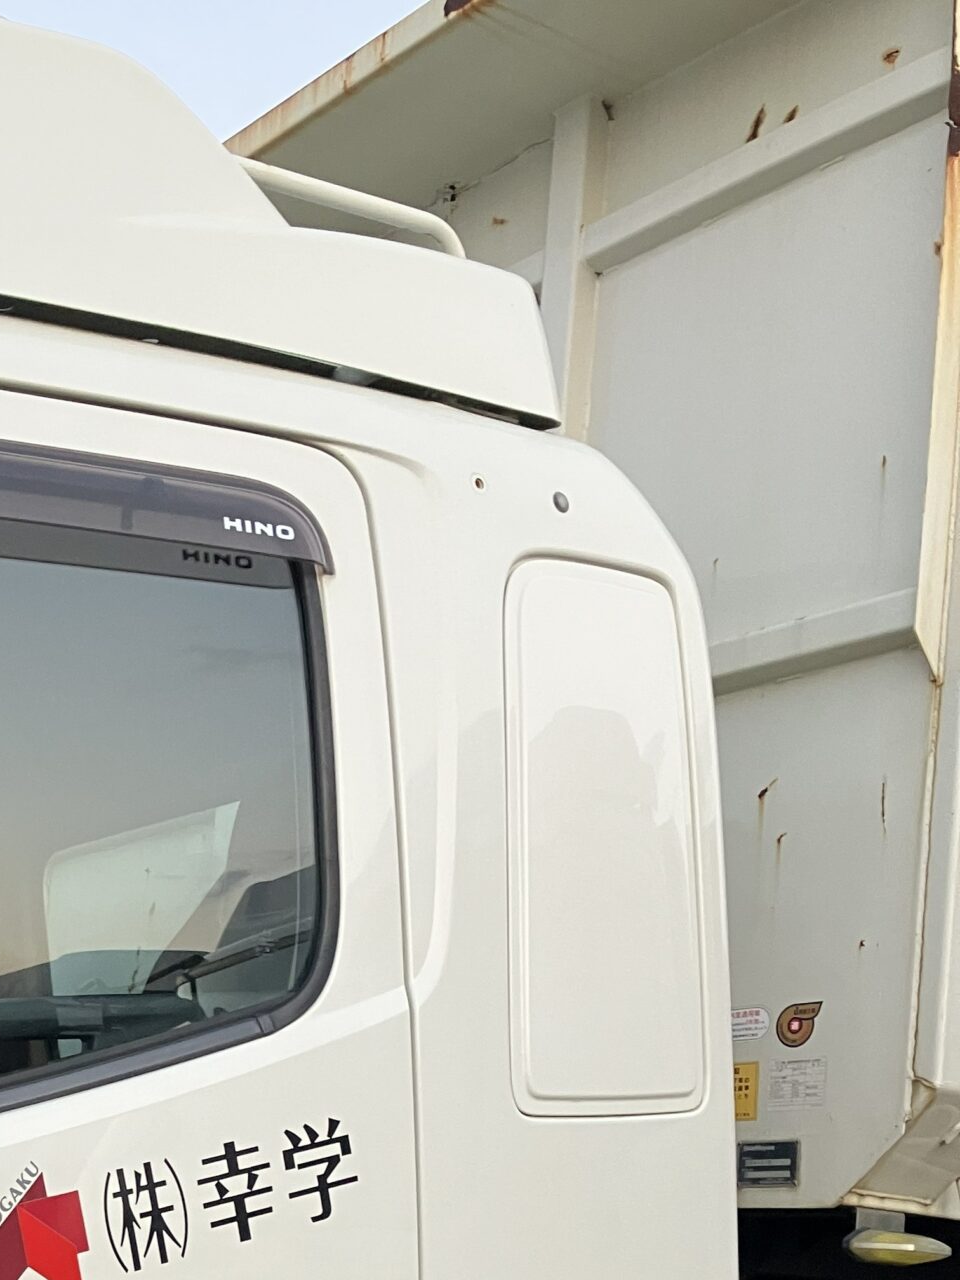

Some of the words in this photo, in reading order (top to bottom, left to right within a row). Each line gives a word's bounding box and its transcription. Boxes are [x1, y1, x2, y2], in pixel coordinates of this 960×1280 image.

[223, 516, 296, 541] HINO
[182, 549, 254, 570] HINO
[104, 1117, 358, 1273] (株)幸学
